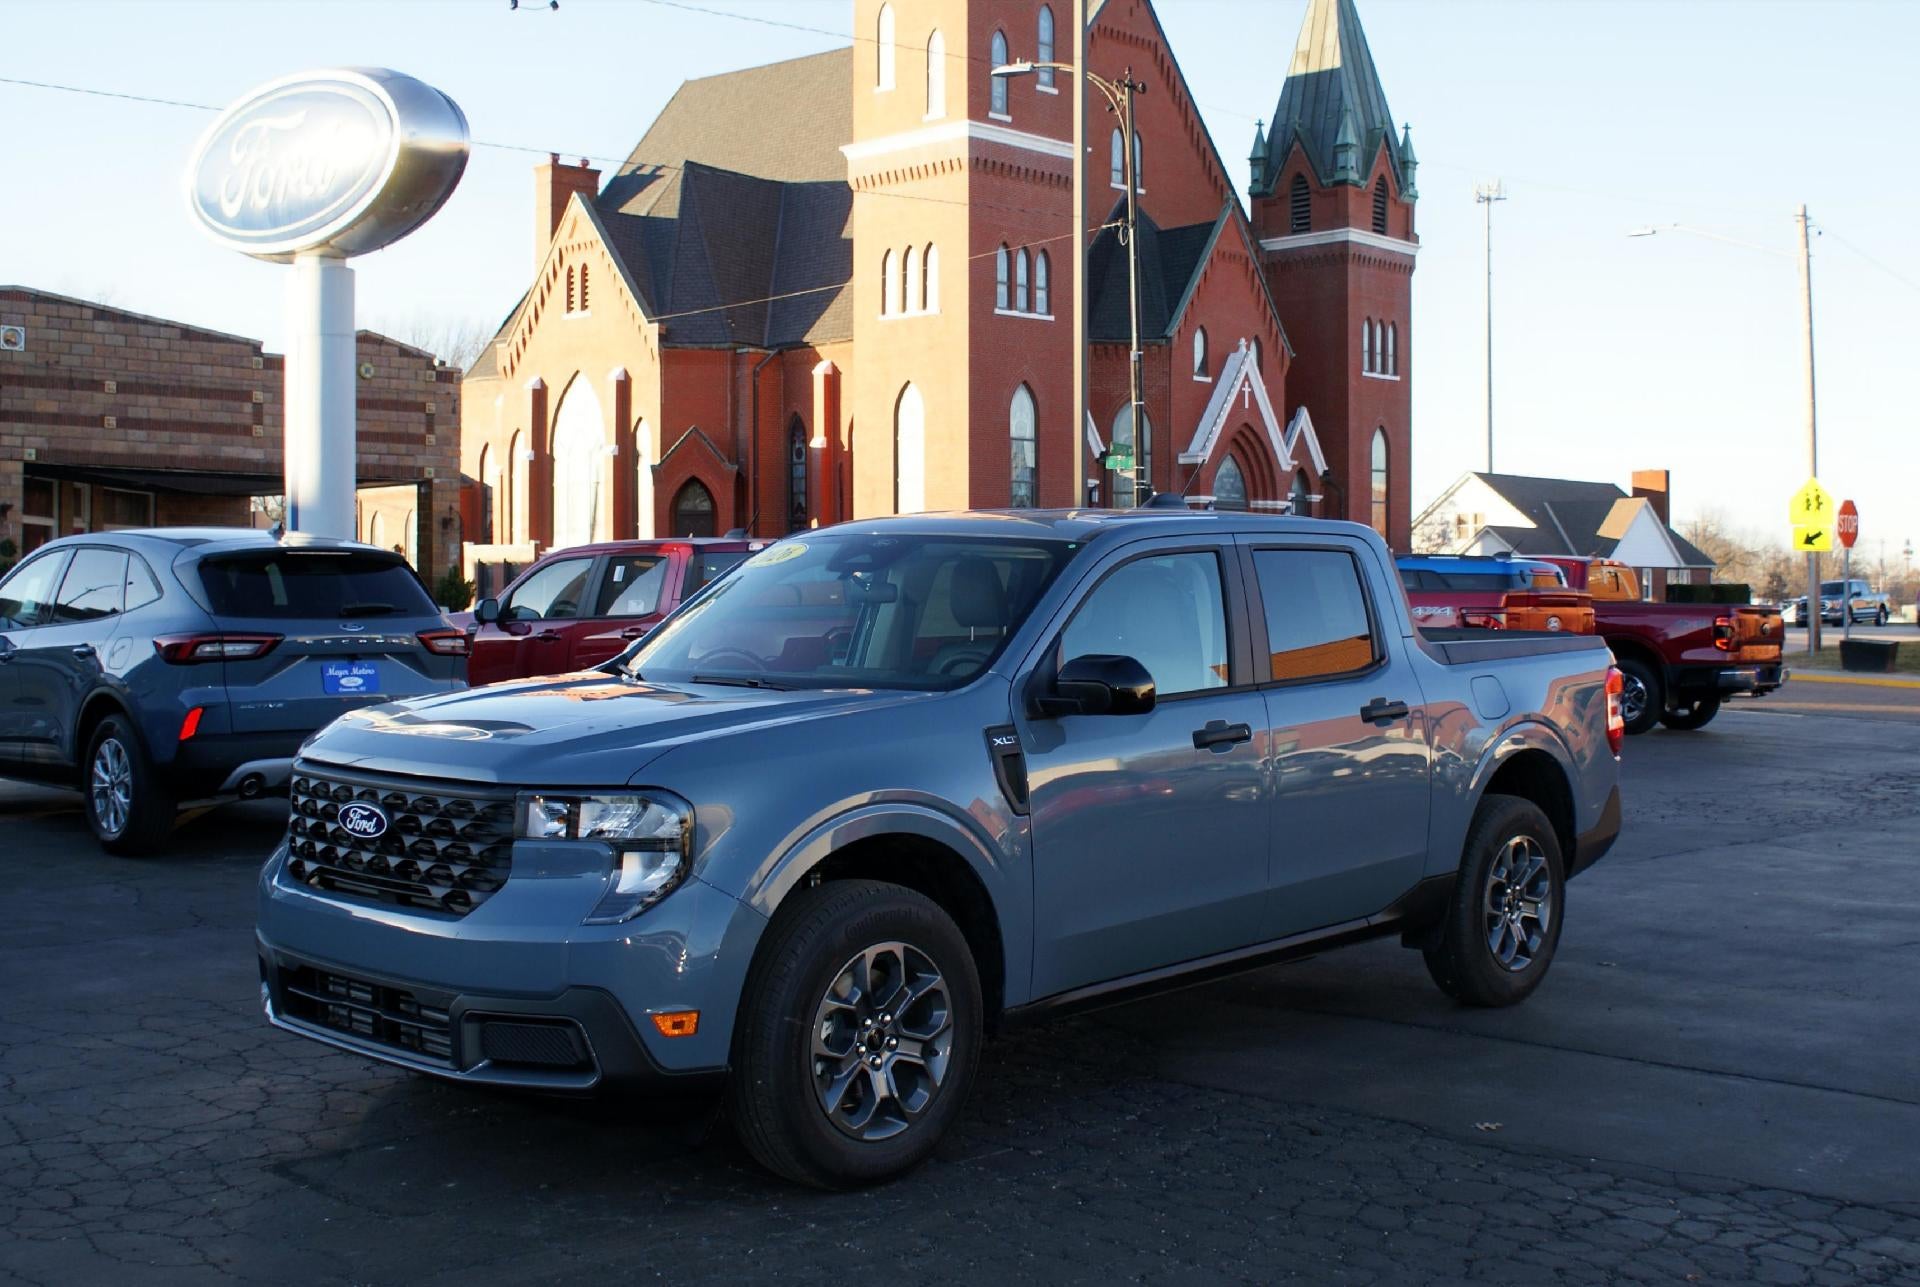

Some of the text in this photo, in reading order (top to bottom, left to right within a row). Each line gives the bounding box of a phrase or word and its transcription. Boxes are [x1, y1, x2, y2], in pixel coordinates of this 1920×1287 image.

[1838, 515, 1858, 532] STOP
[993, 736, 1017, 746] XLT
[346, 807, 378, 833] Ford
